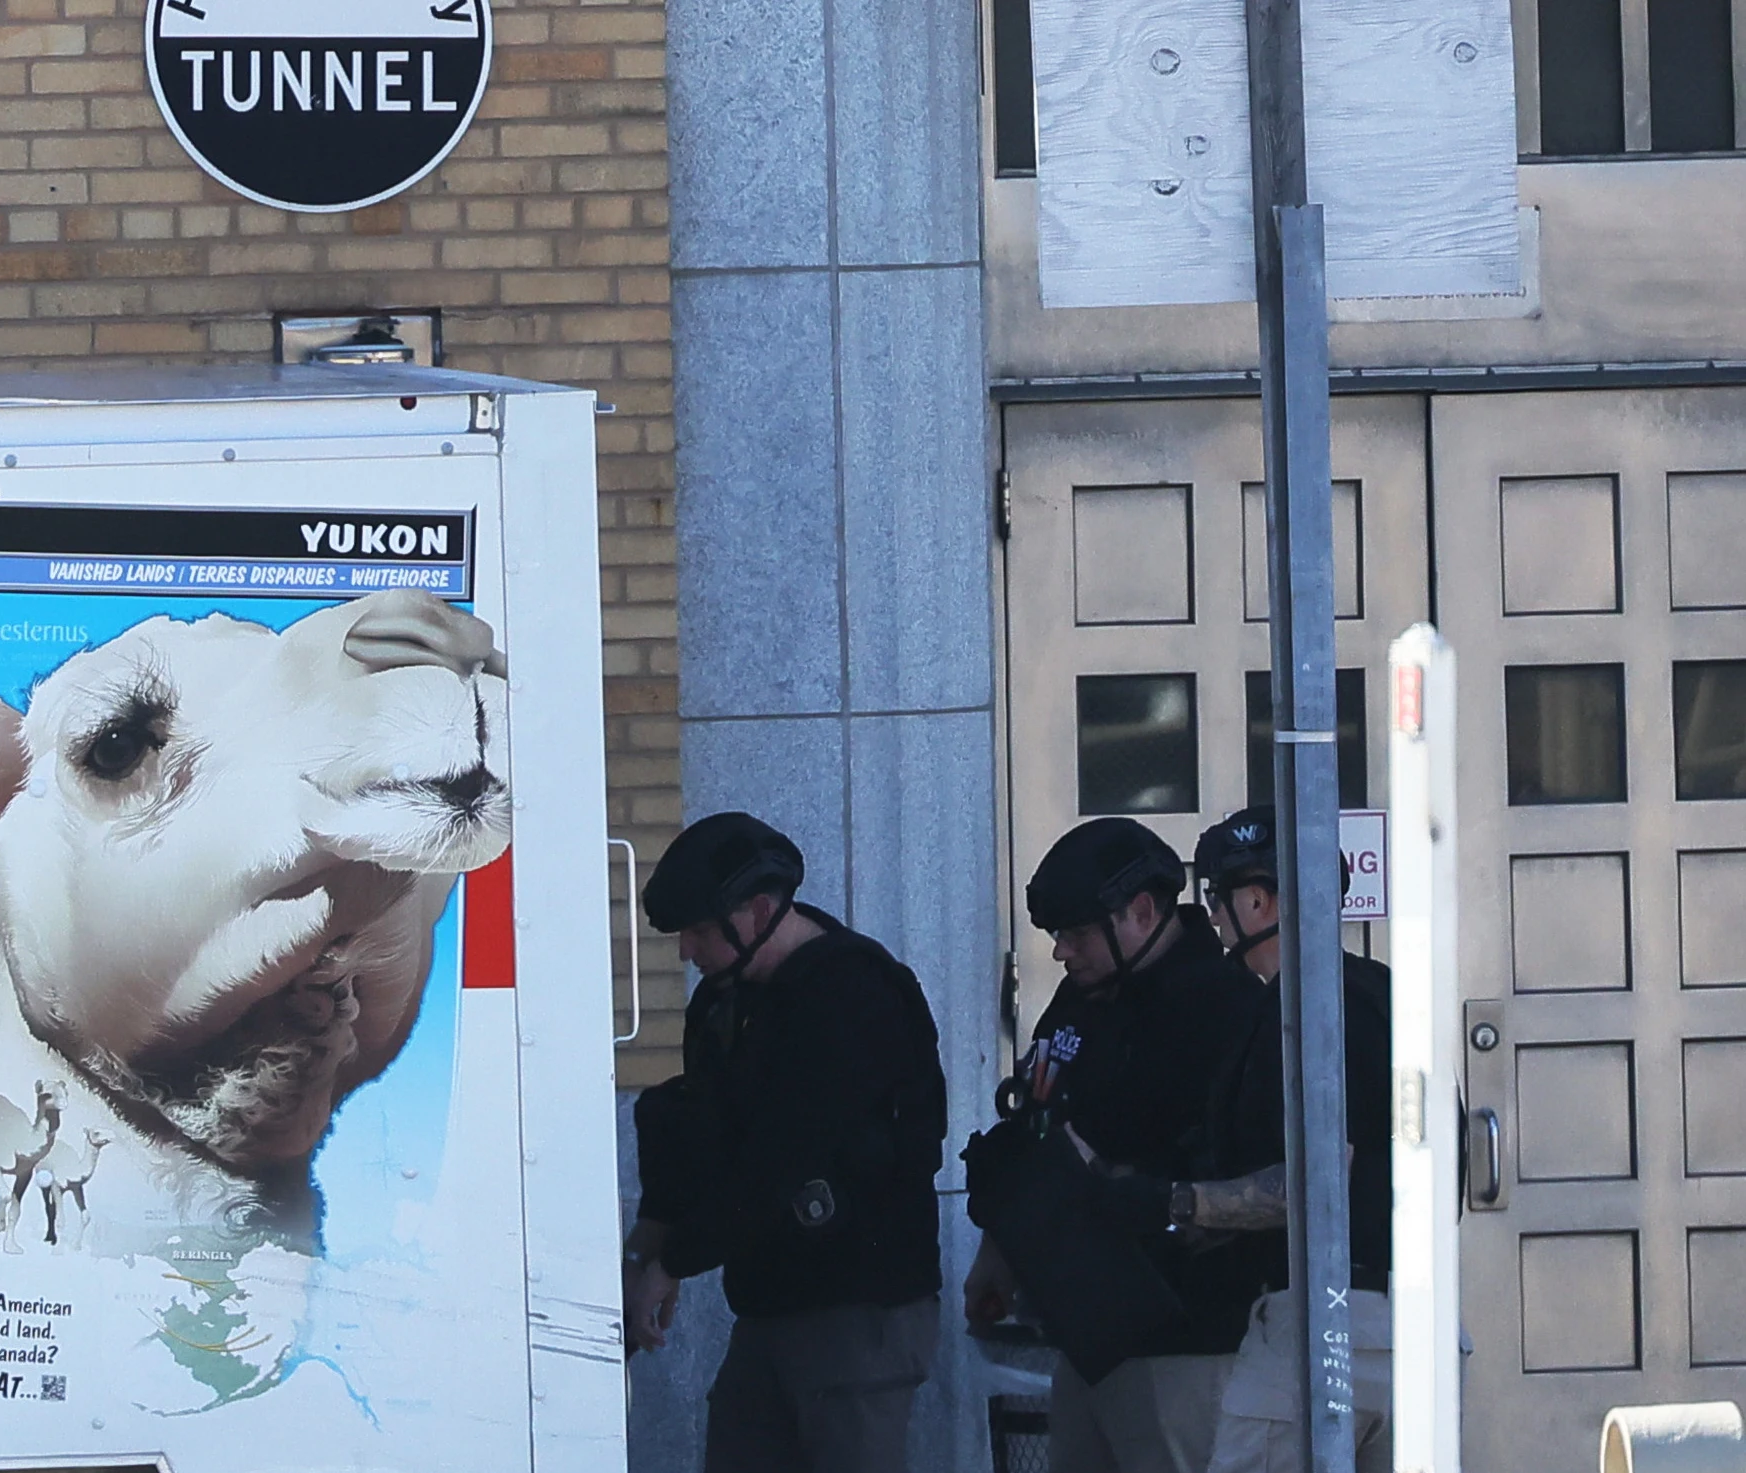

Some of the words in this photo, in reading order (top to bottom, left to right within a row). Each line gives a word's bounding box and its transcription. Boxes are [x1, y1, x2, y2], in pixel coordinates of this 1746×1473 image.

[181, 50, 457, 112] TUNNEL
[300, 521, 449, 556] YUKON
[48, 560, 121, 582] VANISHED
[126, 563, 175, 584] LANDS
[188, 564, 246, 586] TERRES
[250, 565, 336, 587] DISPARUES
[350, 566, 450, 588] WHITEHORSE
[1344, 896, 1376, 908] OOR
[172, 1250, 233, 1261] BERINGIA
[16, 1319, 57, 1340] land.
